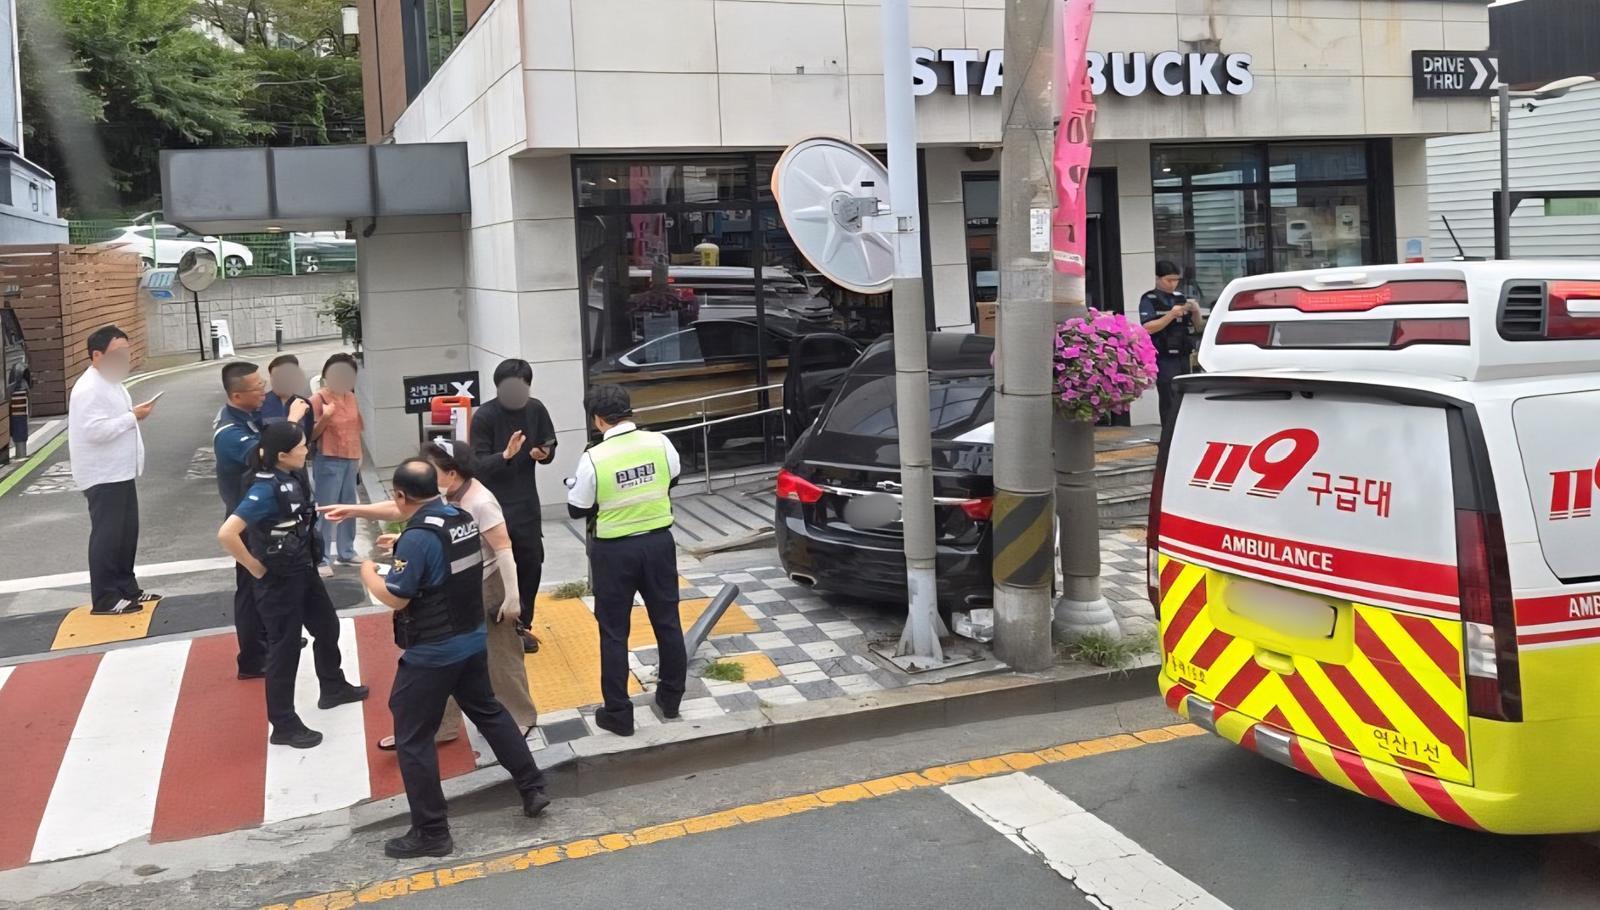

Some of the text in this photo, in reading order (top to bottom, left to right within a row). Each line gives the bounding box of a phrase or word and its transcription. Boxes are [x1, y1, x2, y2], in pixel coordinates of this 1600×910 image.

[911, 47, 1255, 97] STABUCKS
[1422, 56, 1466, 74] DRIVE
[1423, 73, 1464, 91] THRU
[1188, 427, 1393, 519] 119 구급대
[1549, 456, 1600, 521] 11
[449, 521, 479, 542] POLIC
[1220, 532, 1334, 573] AMBULANCE
